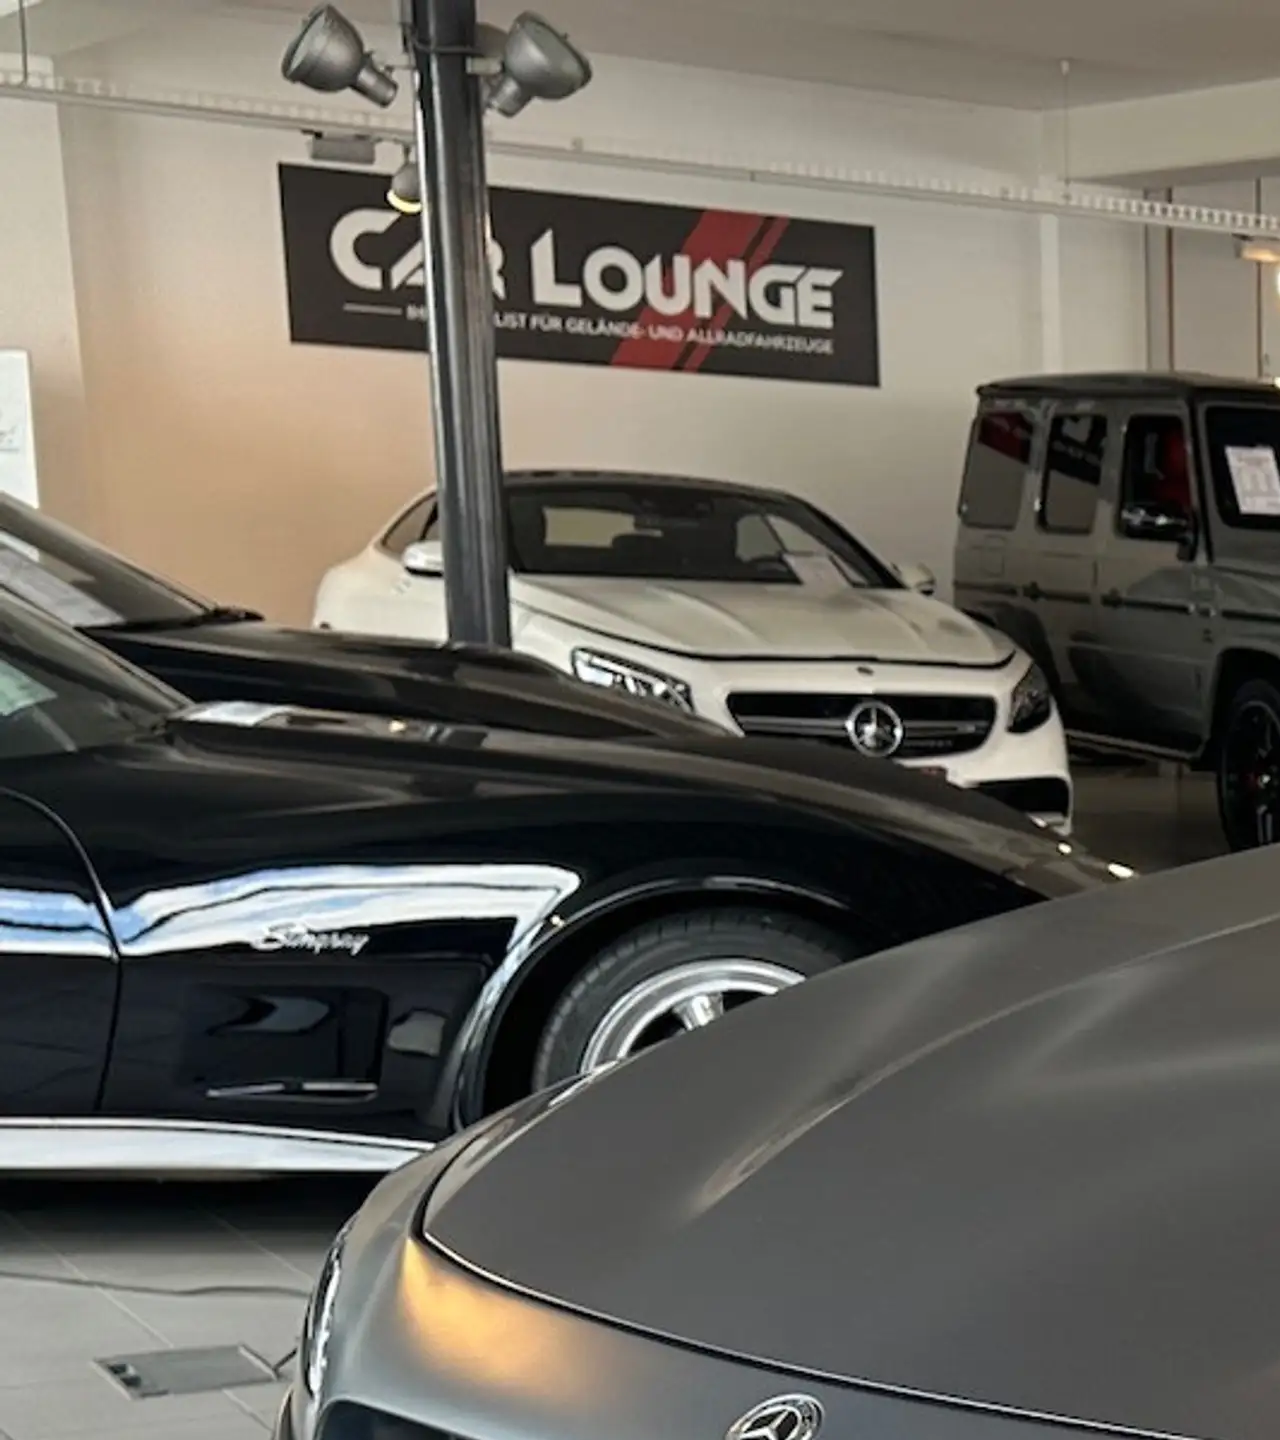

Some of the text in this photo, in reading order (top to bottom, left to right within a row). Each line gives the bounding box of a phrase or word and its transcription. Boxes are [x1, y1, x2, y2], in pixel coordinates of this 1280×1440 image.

[530, 228, 844, 329] LOUNGE
[529, 314, 564, 334] FÜR
[648, 326, 683, 342] UND
[685, 327, 835, 355] ALLRADFAHRZEUGE
